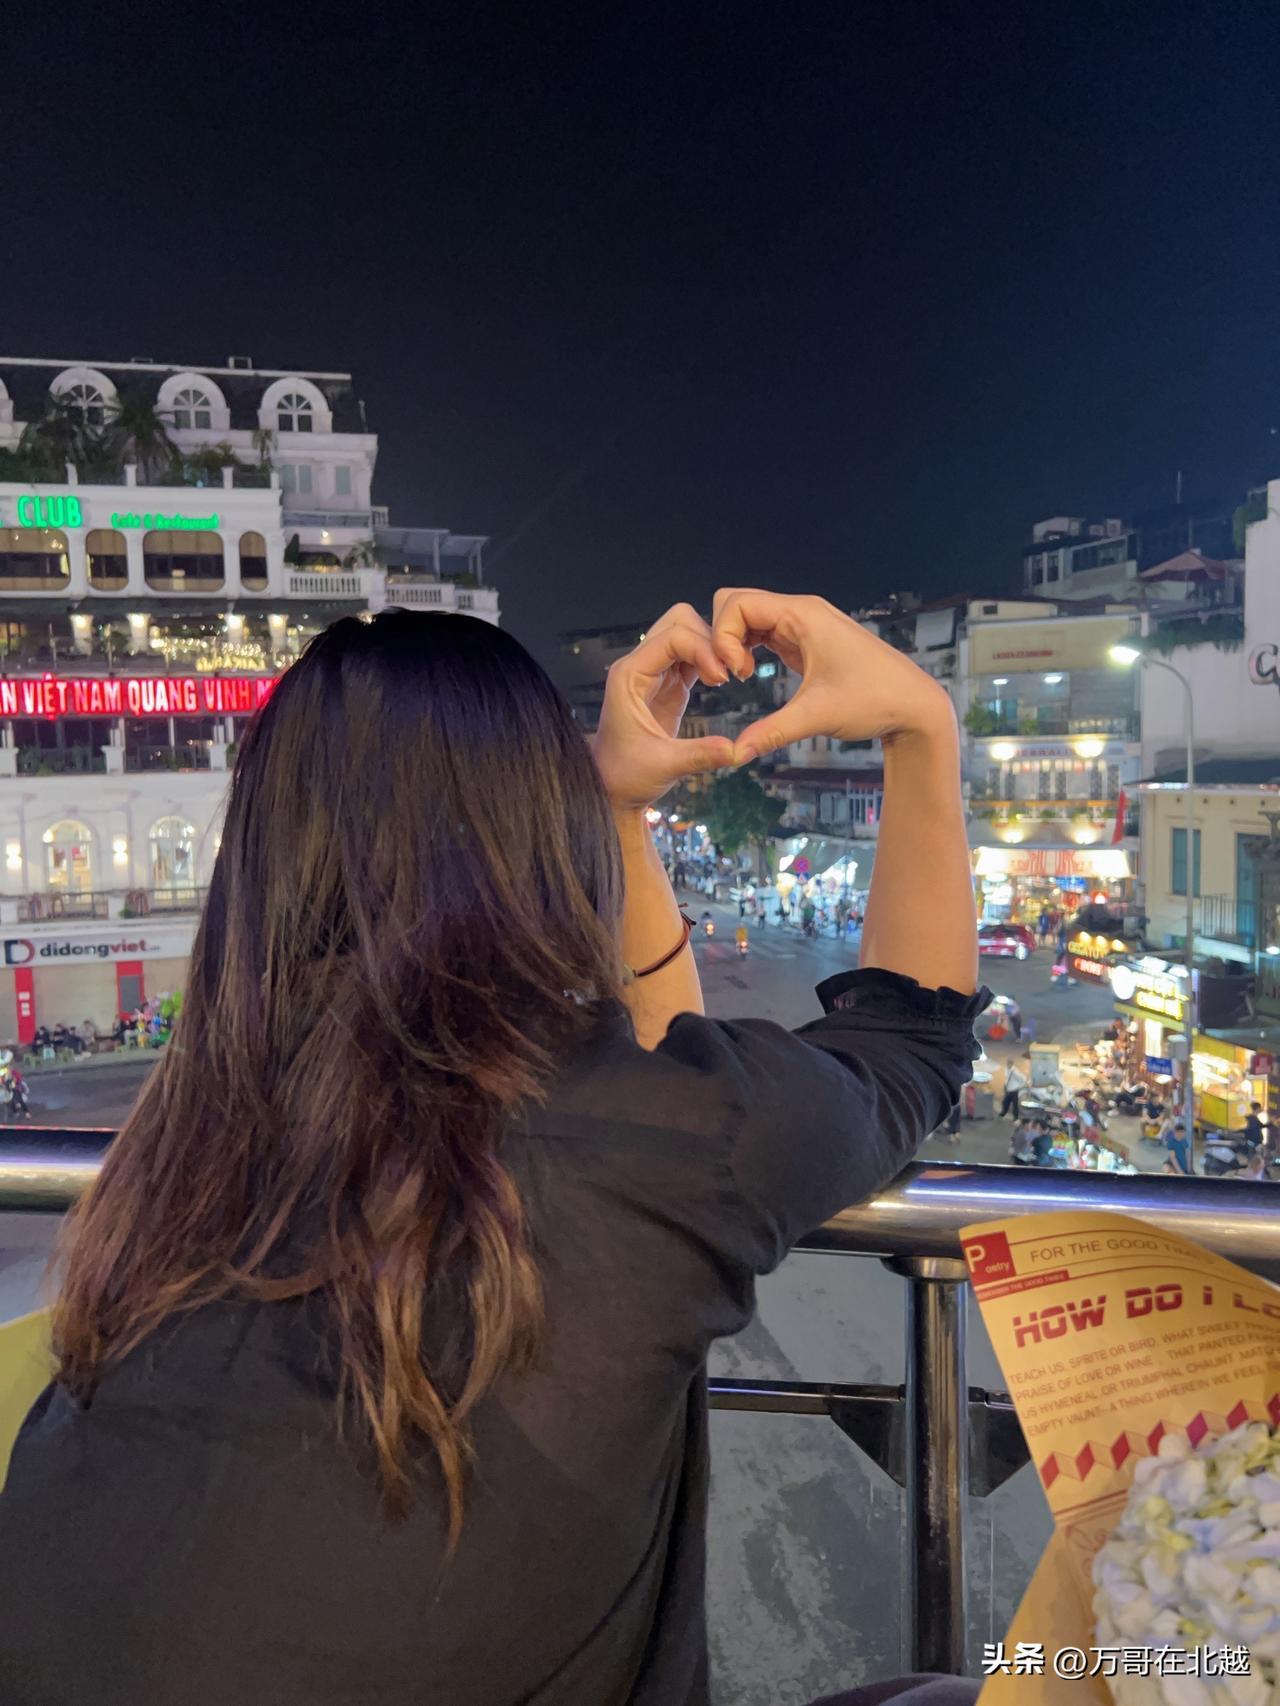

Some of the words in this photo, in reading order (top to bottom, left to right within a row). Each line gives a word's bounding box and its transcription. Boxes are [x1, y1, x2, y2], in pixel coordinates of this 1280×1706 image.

[18, 496, 82, 528] CLUB
[0, 681, 18, 714] N
[22, 672, 68, 720] VIỆT
[74, 680, 122, 712] NAM
[128, 679, 197, 717] QUANG
[203, 679, 250, 711] VINH
[40, 939, 146, 957] didongviet
[1030, 1245, 1064, 1262] FOR
[1068, 1240, 1102, 1255] THE
[1106, 1238, 1158, 1251] GOOD
[1012, 1295, 1107, 1348] HOW
[1125, 1283, 1183, 1319] DO
[1010, 1367, 1046, 1384] TEACH
[1069, 1349, 1107, 1368] SPRITE
[1109, 1344, 1125, 1357] OR
[1162, 1328, 1194, 1343] WHAT
[1015, 1382, 1055, 1400] PRAISE
[1057, 1377, 1072, 1390] OF
[1075, 1368, 1103, 1385] LOVE
[1105, 1363, 1121, 1376] OR
[1124, 1355, 1153, 1371] WINE
[1168, 1344, 1195, 1359] THAT
[1026, 1418, 1063, 1436] EMPTY
[1211, 1373, 1230, 1385] WE
[1233, 1365, 1264, 1379] FEEL
[1101, 1383, 1117, 1396] OR
